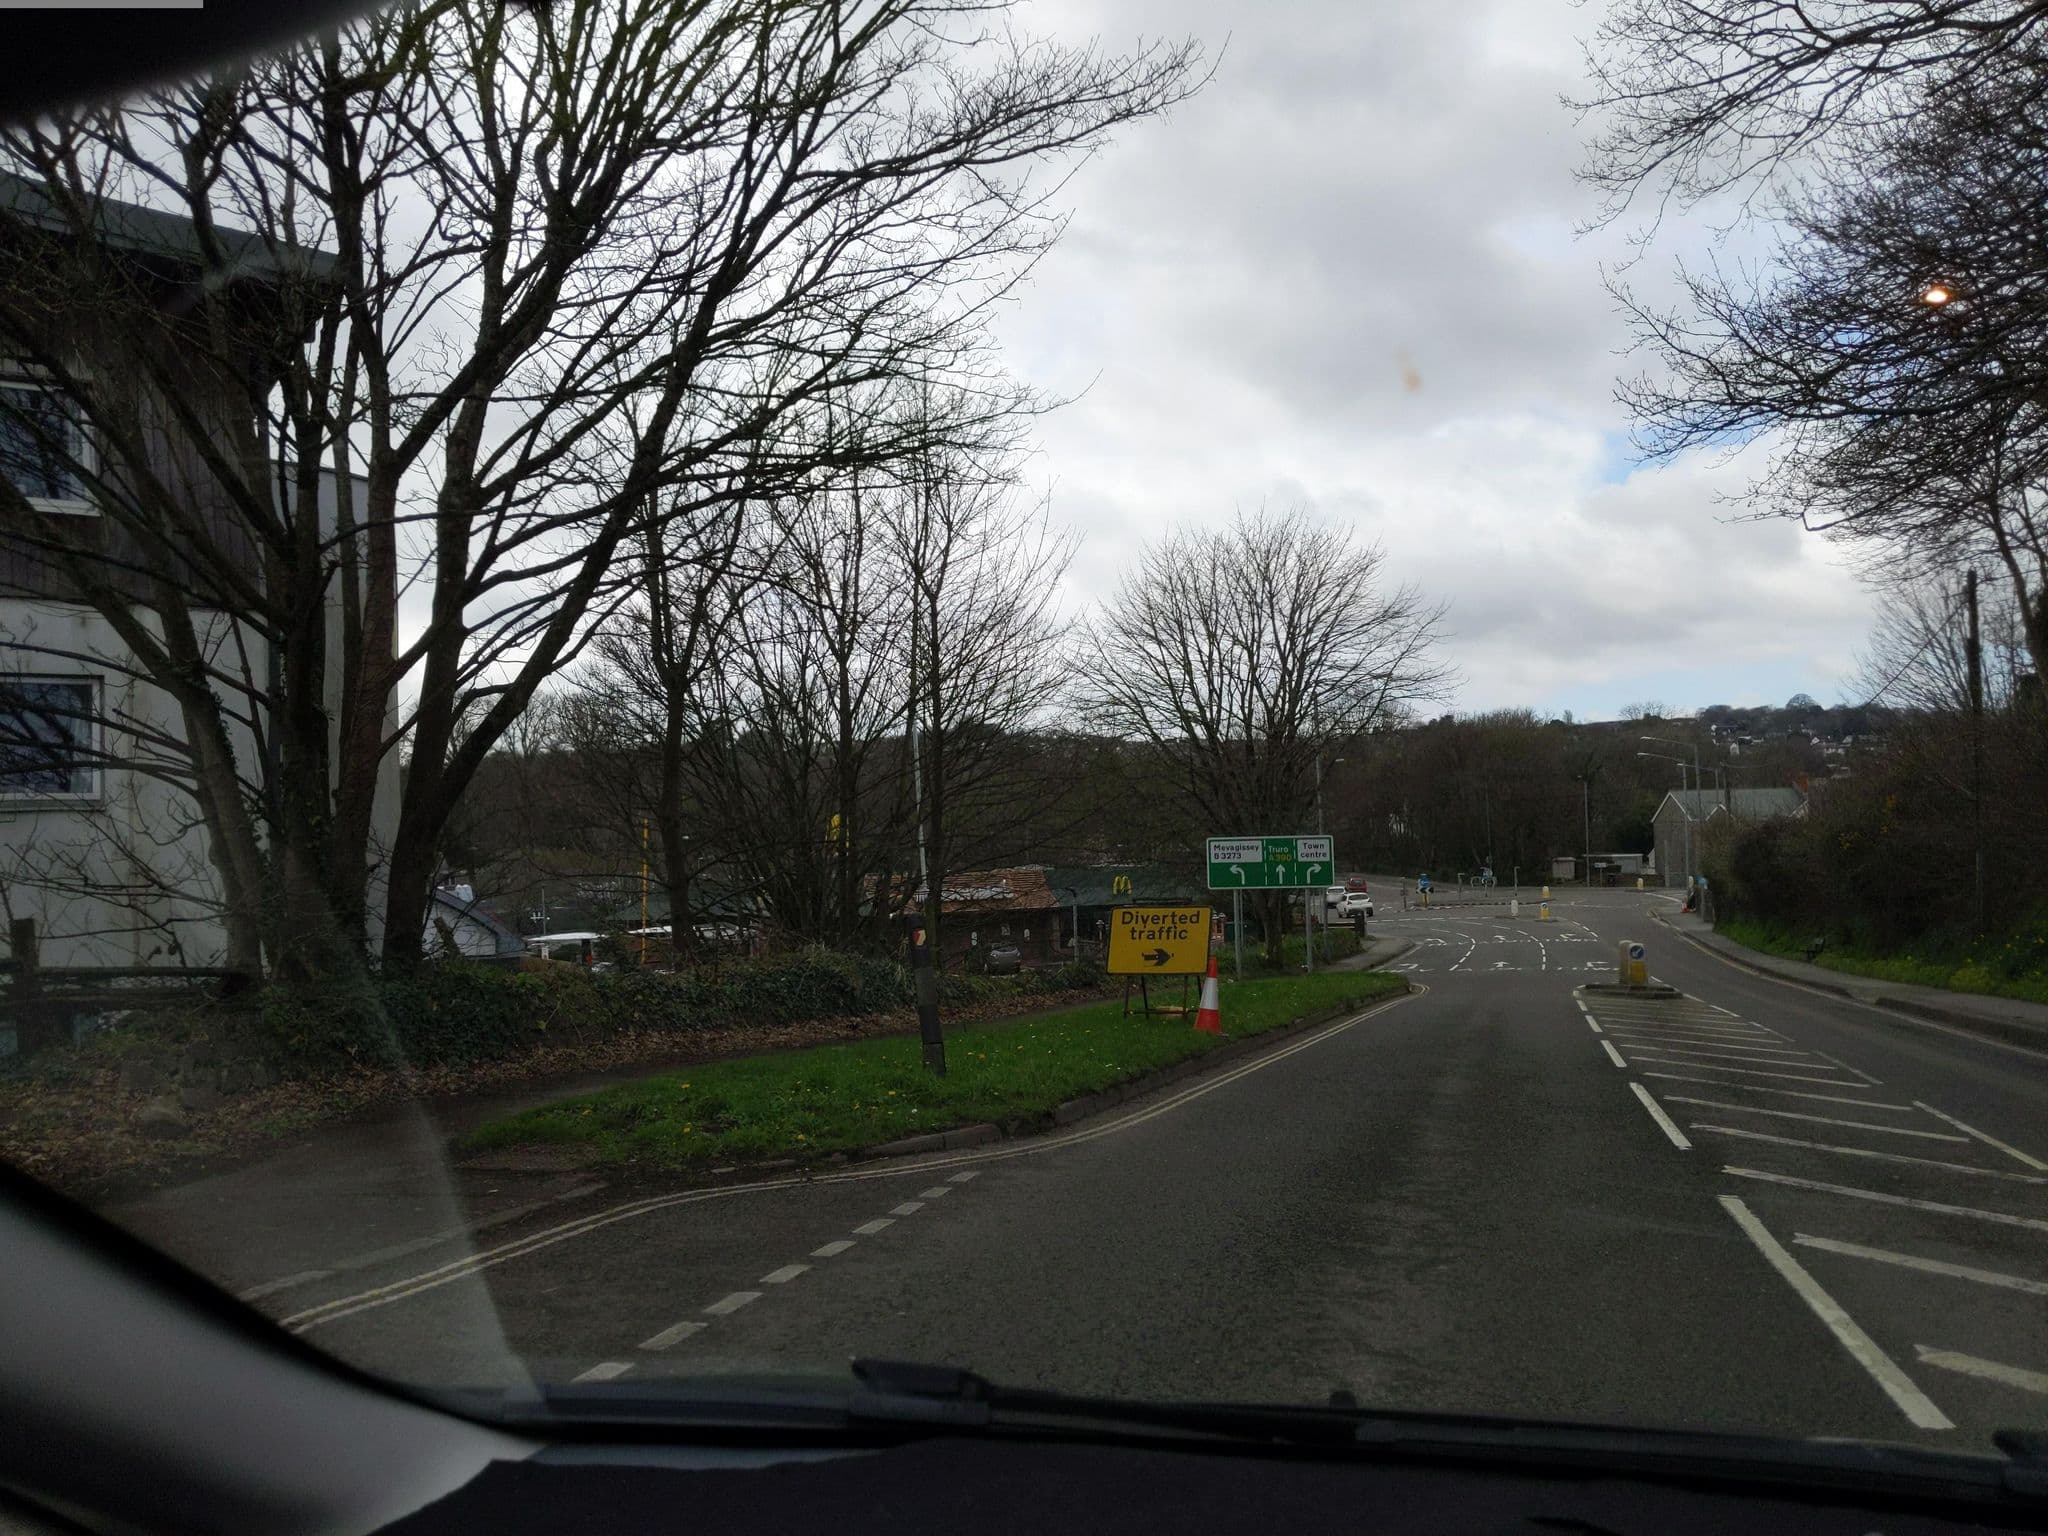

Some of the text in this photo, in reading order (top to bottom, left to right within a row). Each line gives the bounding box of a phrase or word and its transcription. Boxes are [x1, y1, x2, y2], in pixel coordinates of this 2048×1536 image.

[1213, 843, 1259, 852] Mevagissey
[1268, 845, 1289, 854] Truro
[1303, 842, 1325, 850] Town
[1300, 851, 1327, 859] centre
[1121, 910, 1200, 928] Diverted
[1130, 926, 1188, 940] traffic
